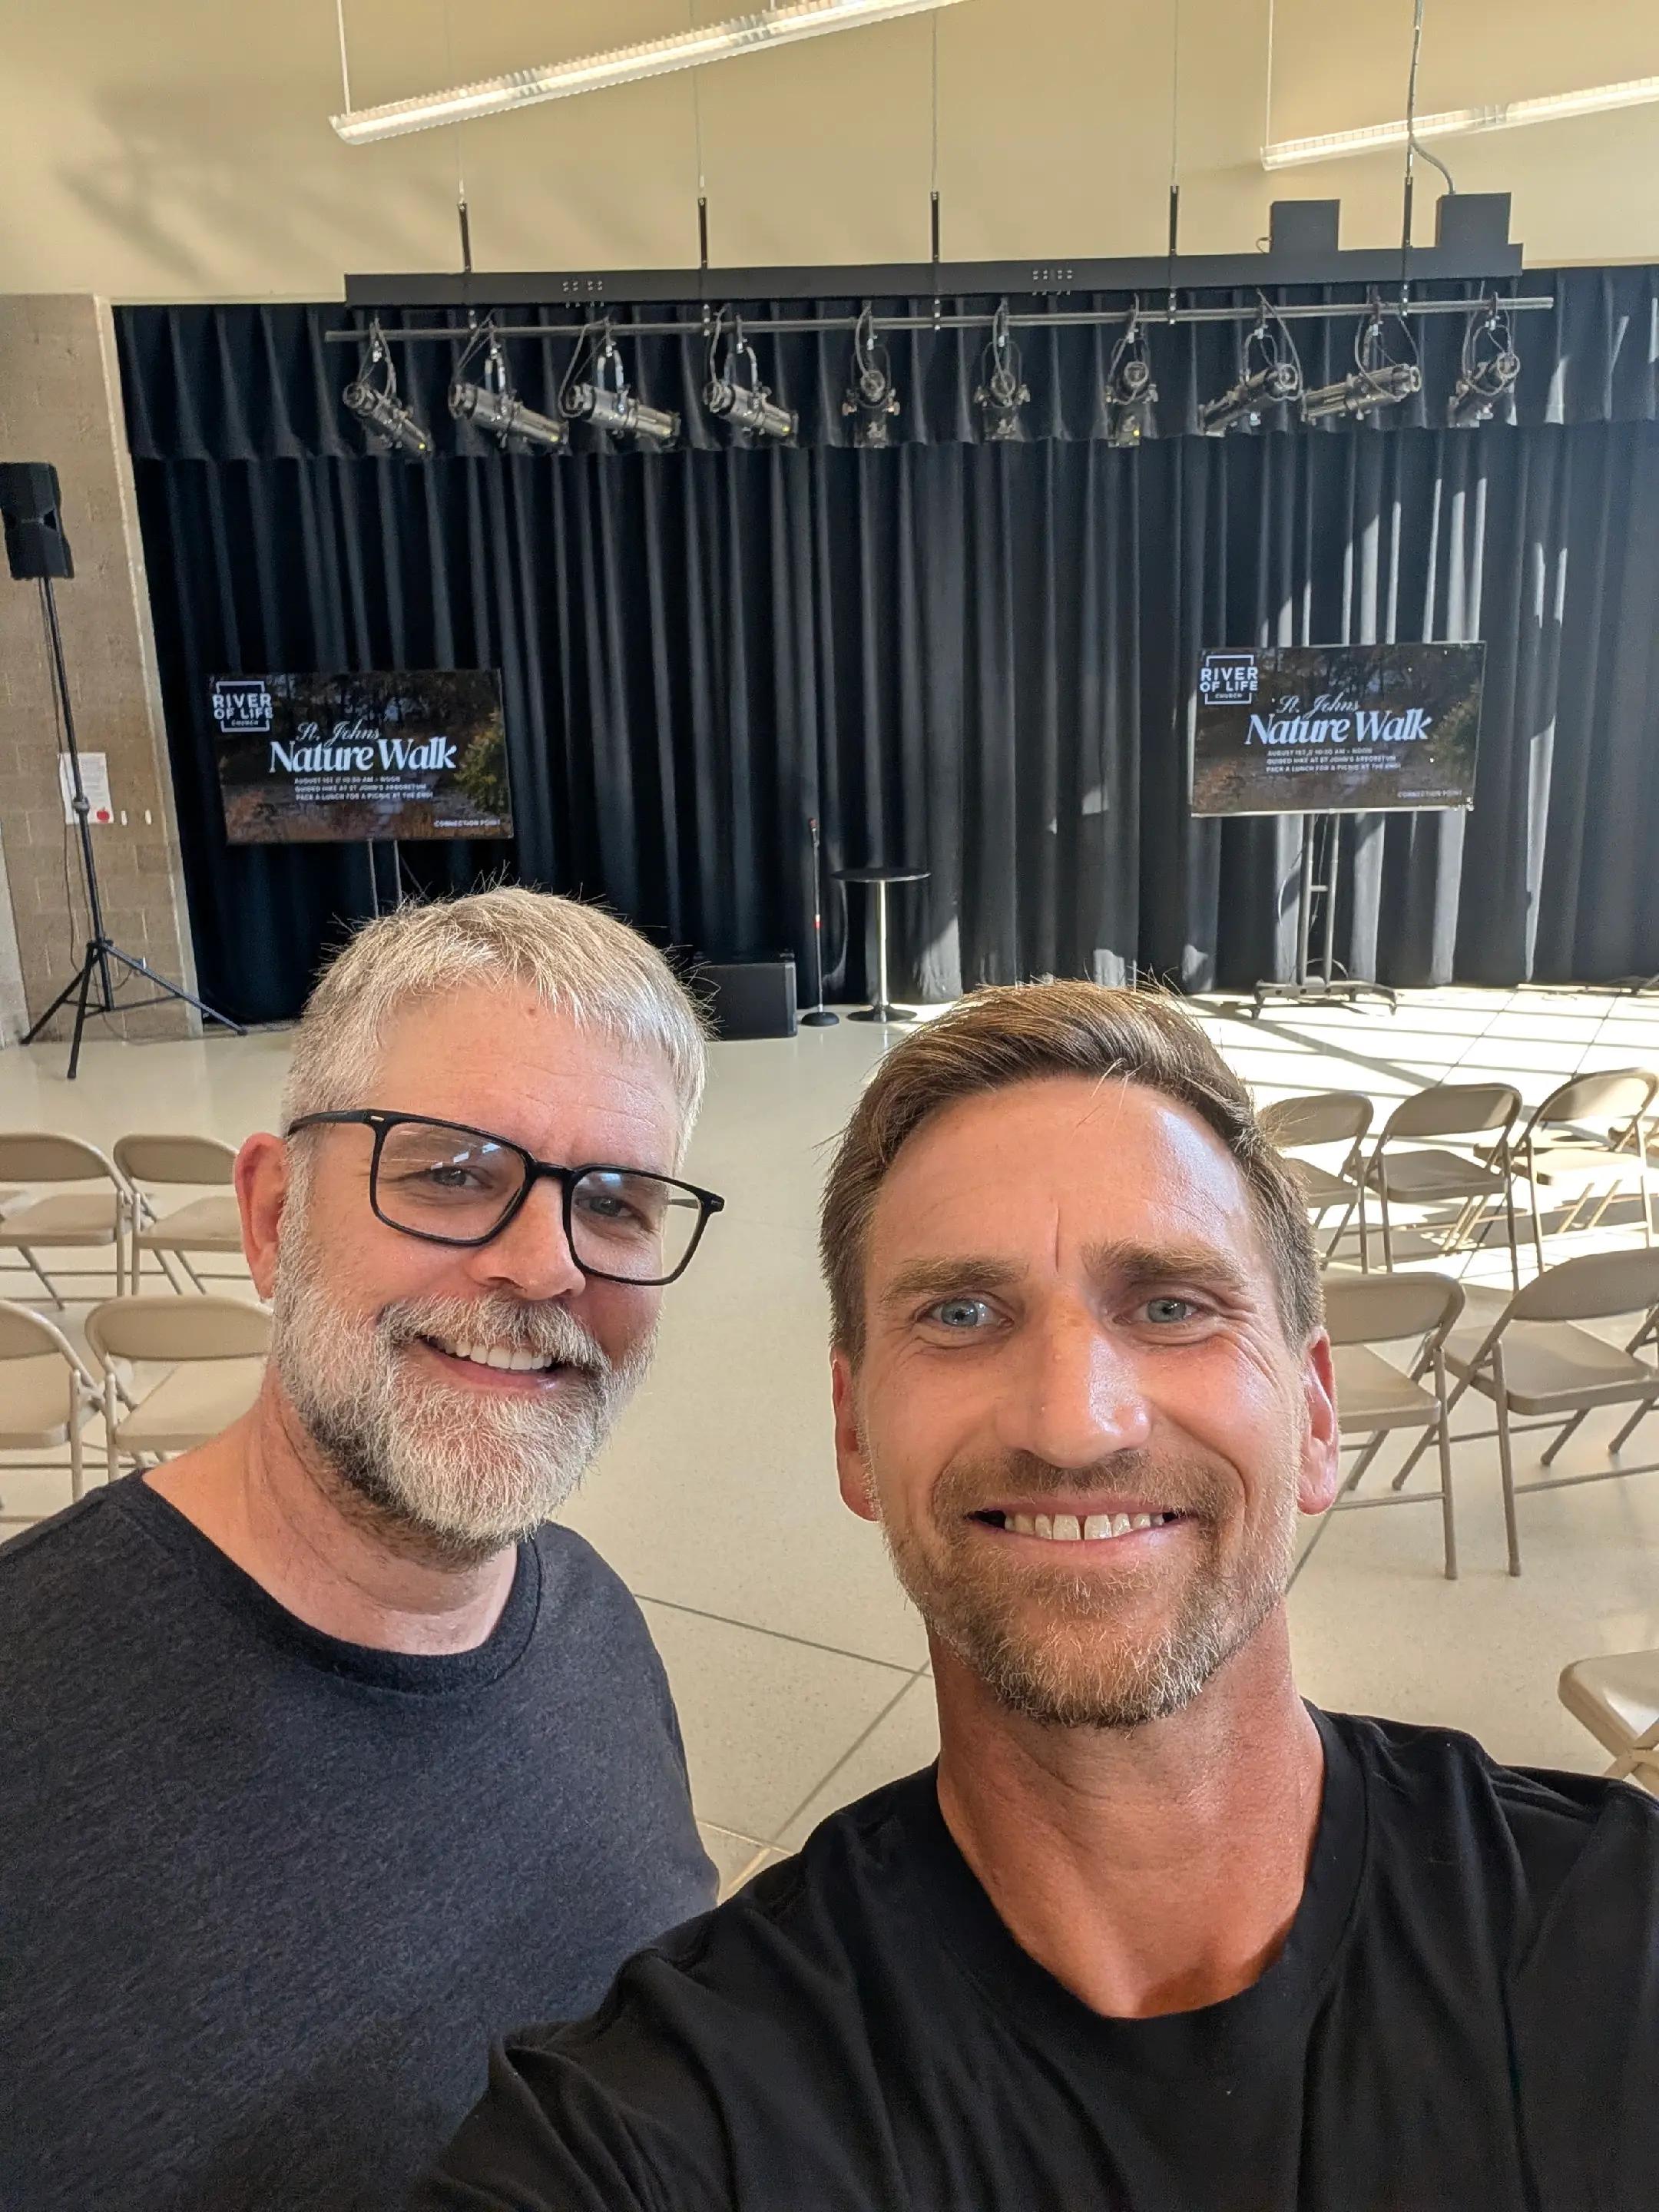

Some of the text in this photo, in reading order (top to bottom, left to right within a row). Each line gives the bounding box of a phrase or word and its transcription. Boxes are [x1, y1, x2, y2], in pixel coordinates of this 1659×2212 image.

[1200, 667, 1258, 681] RIVER
[1200, 680, 1258, 692] OF LIFE
[212, 693, 272, 708] RIVER
[1303, 691, 1359, 719] Johns
[214, 707, 273, 720] OF LIFE
[323, 718, 381, 747] Johns
[1244, 708, 1432, 745] Nature Walk
[269, 736, 457, 773] Nature Walk
